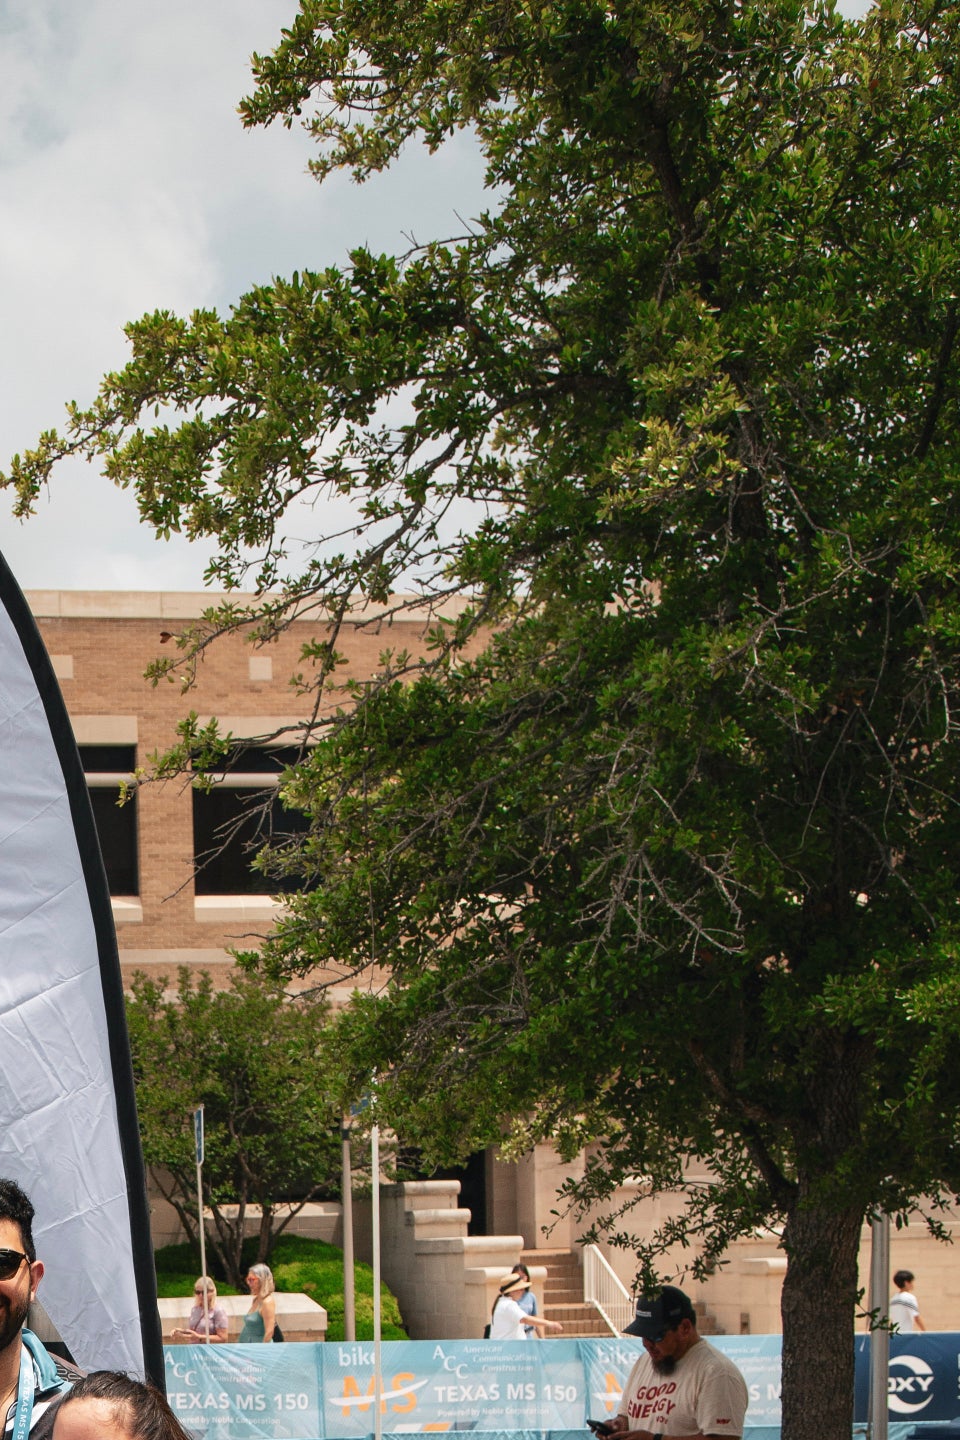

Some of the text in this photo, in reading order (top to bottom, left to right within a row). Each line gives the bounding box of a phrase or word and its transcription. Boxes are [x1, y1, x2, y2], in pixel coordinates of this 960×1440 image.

[165, 1351, 197, 1386] ACC
[433, 1345, 468, 1380] ACC
[21, 1384, 30, 1413] TEXAS
[166, 1393, 309, 1411] TEXAS MS 150
[342, 1372, 418, 1417] MS
[434, 1383, 577, 1402] TEXAS MS 150
[637, 1382, 677, 1400] GOOD
[19, 1414, 27, 1428] MS
